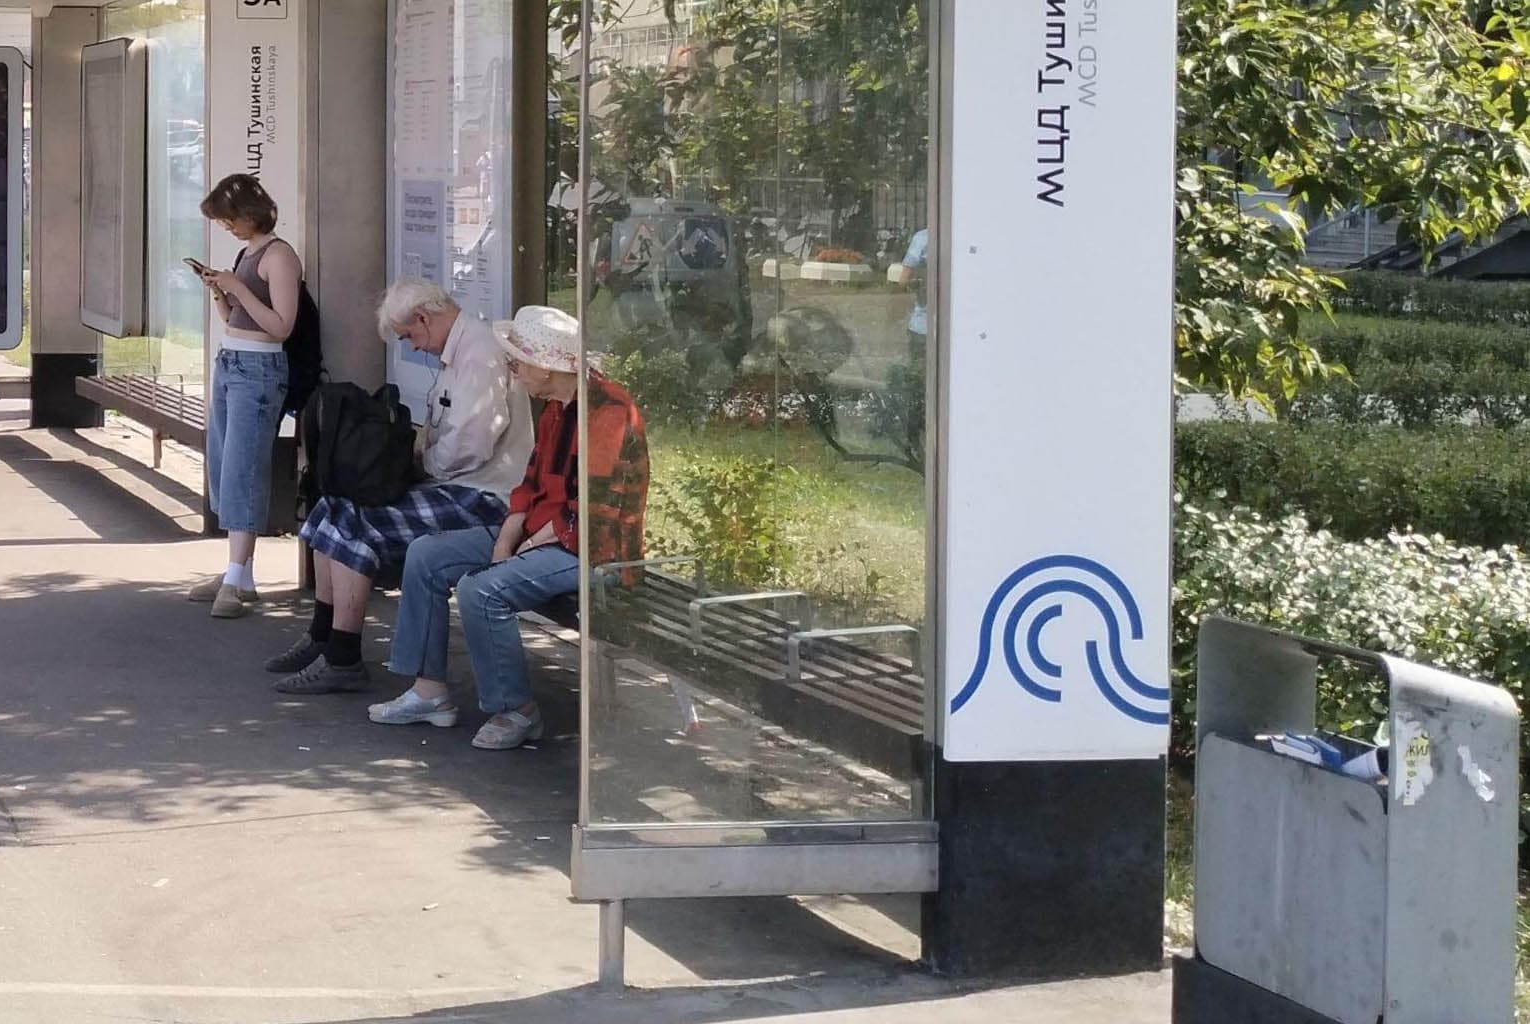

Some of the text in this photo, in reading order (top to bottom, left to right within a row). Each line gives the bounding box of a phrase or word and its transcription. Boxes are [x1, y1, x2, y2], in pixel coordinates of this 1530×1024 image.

[246, 45, 264, 138] Тушинская
[265, 45, 279, 145] MCD Tushinskaya
[1077, 44, 1097, 107] MCD
[1036, 104, 1071, 208] МЦД
